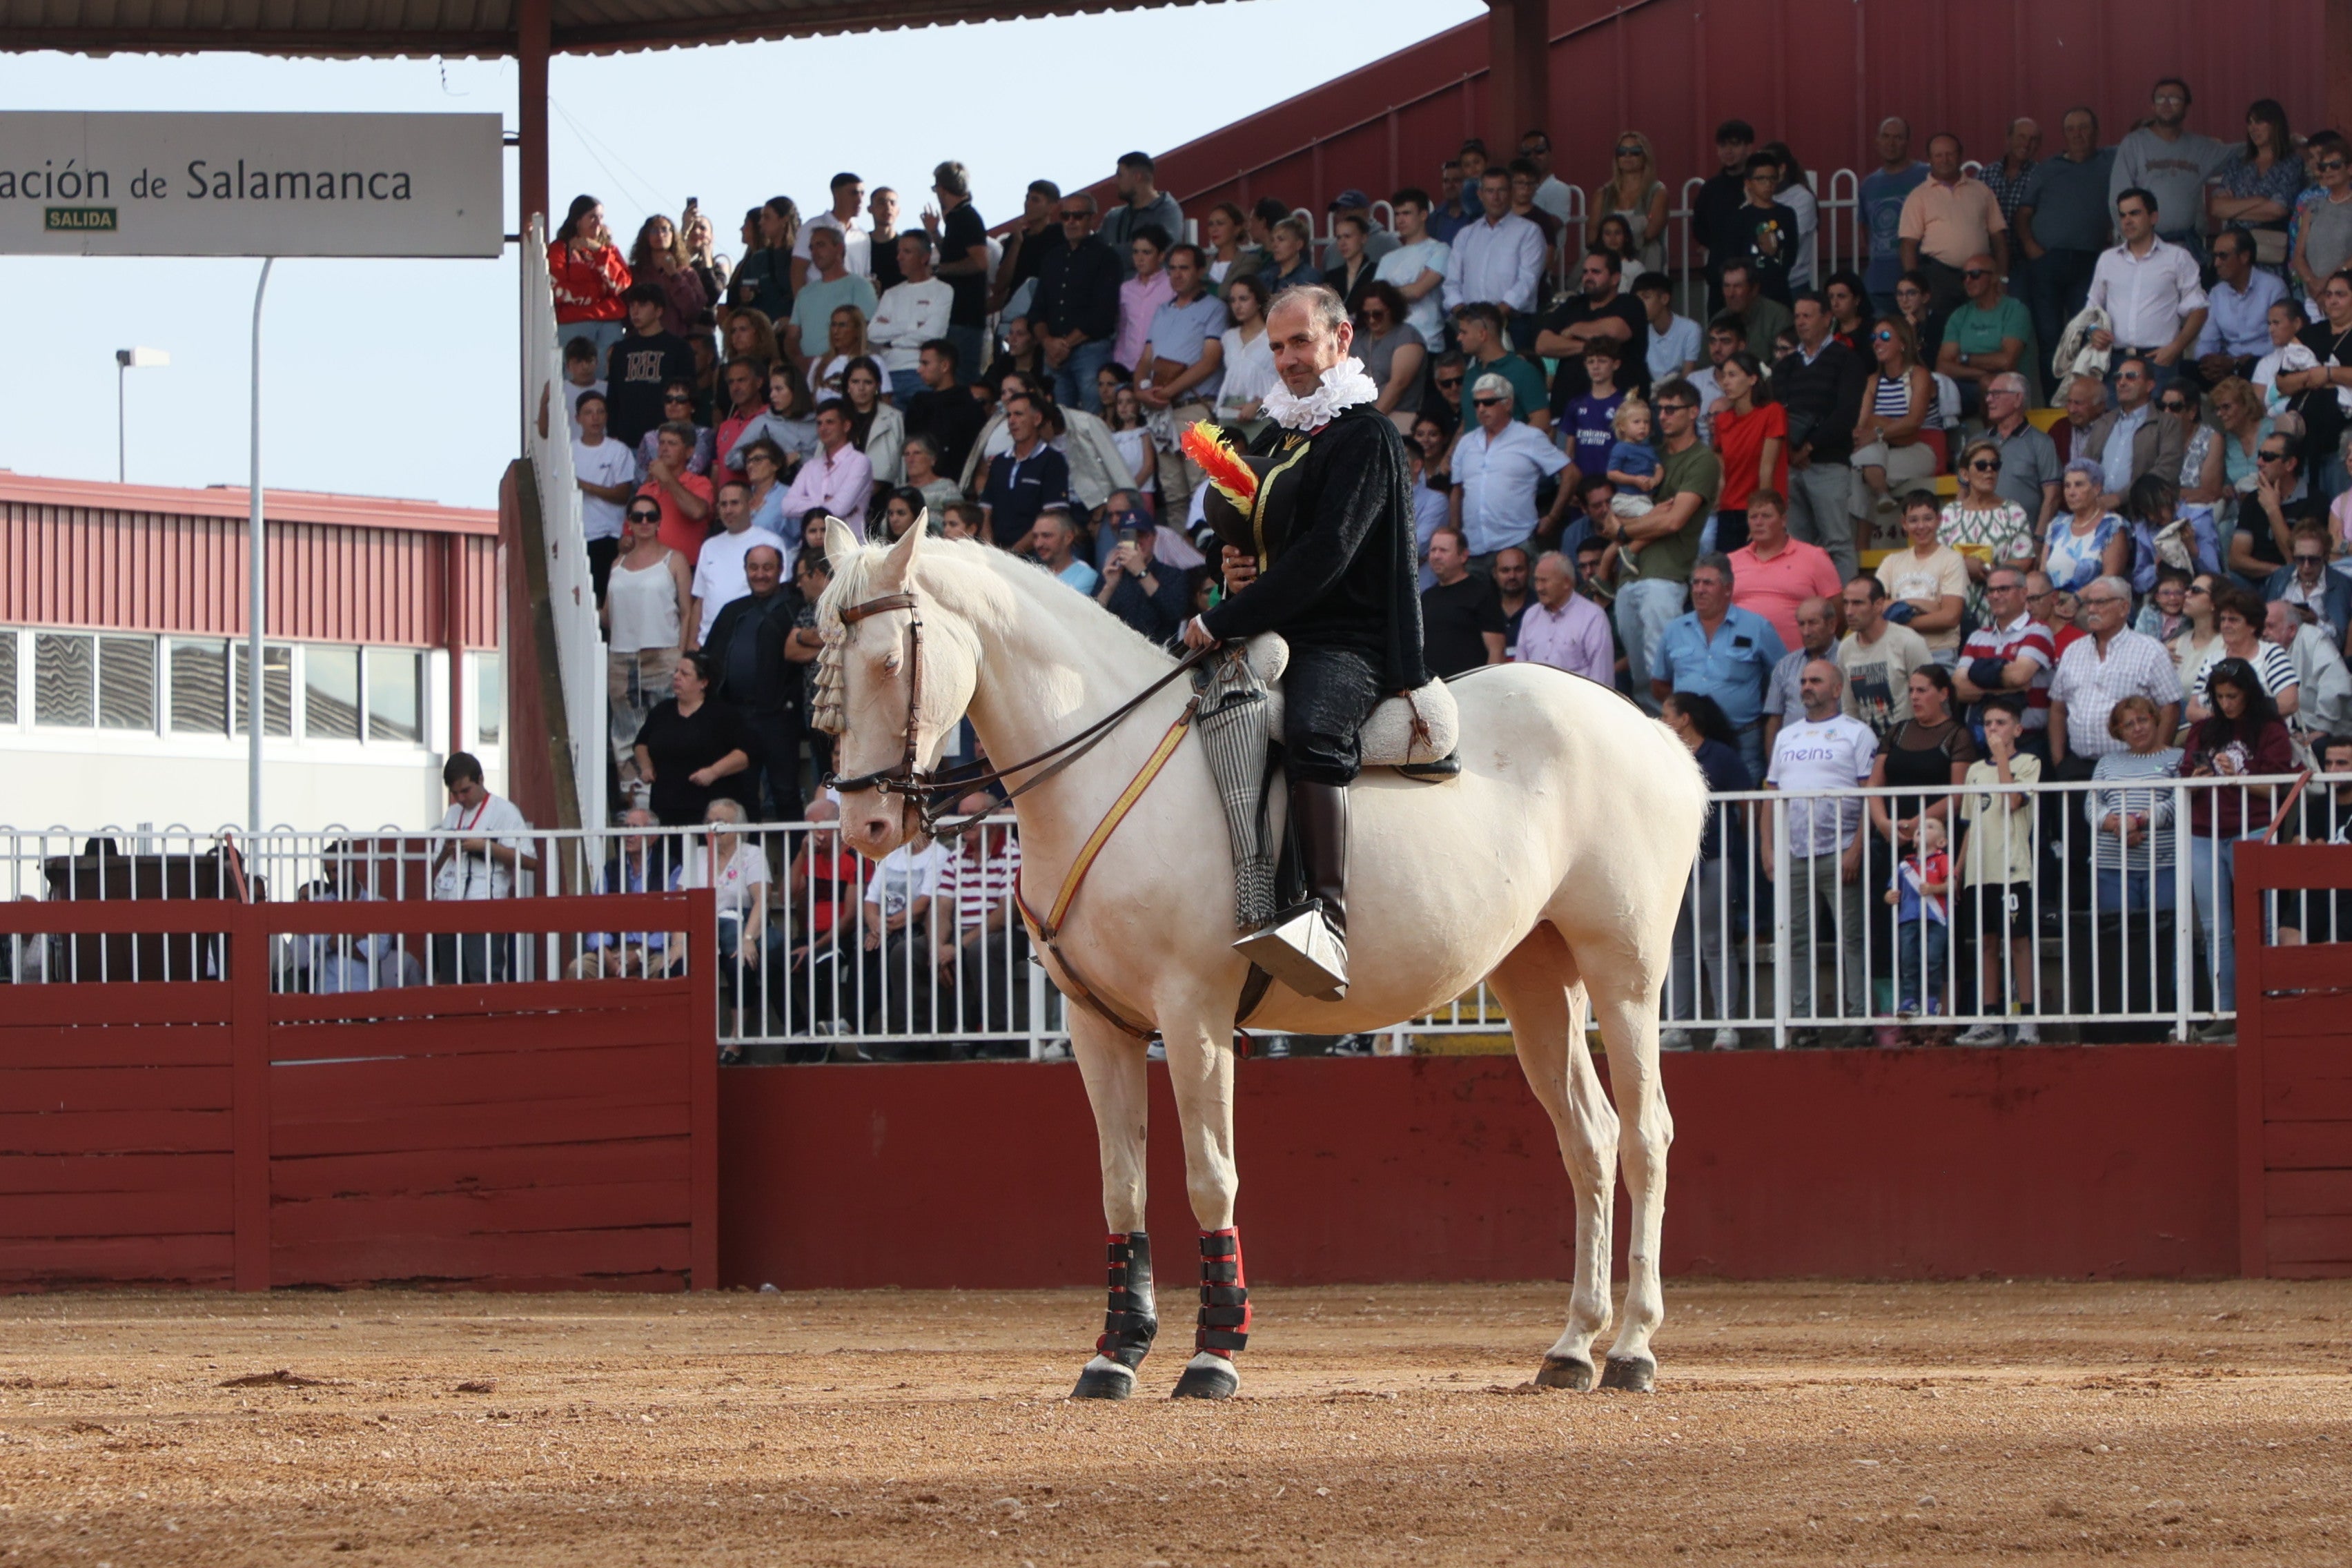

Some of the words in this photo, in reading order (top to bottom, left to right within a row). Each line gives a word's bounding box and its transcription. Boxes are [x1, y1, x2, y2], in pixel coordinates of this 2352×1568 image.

[0, 159, 109, 199] ación
[130, 168, 167, 199] de
[187, 159, 411, 199] Salamanca
[50, 211, 112, 227] SALIDA
